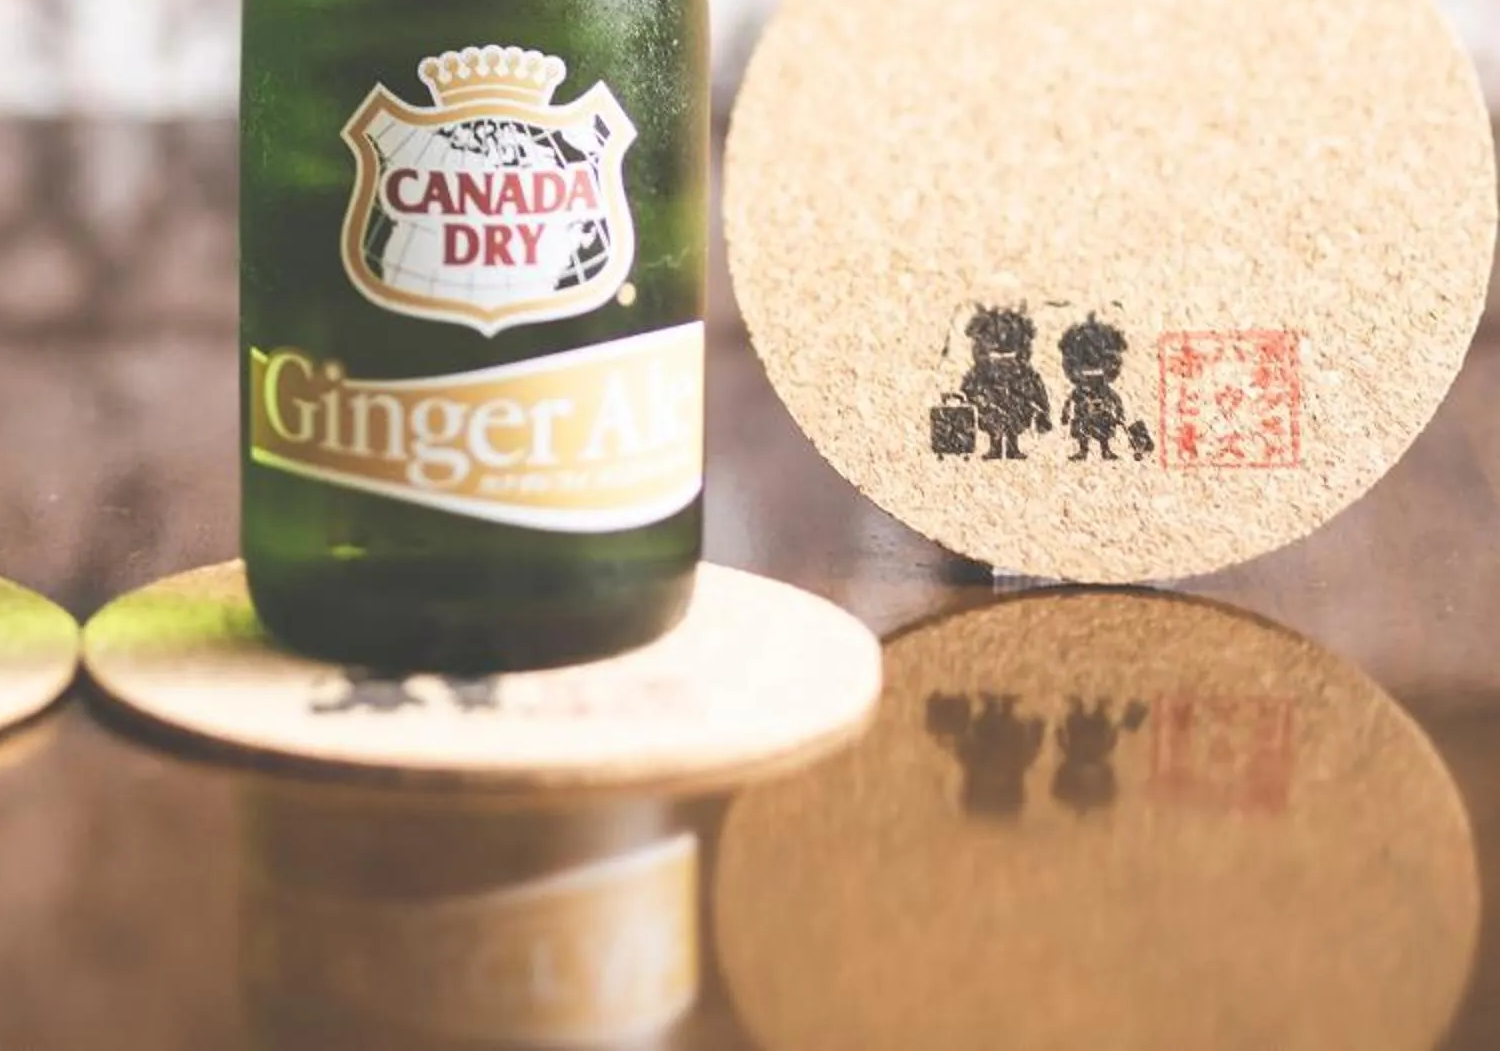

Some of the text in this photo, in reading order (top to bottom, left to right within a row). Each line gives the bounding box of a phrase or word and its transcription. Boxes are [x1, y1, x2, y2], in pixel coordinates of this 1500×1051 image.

[385, 168, 598, 215] CANADA
[443, 223, 546, 267] DRY
[264, 350, 577, 489] Ginger
